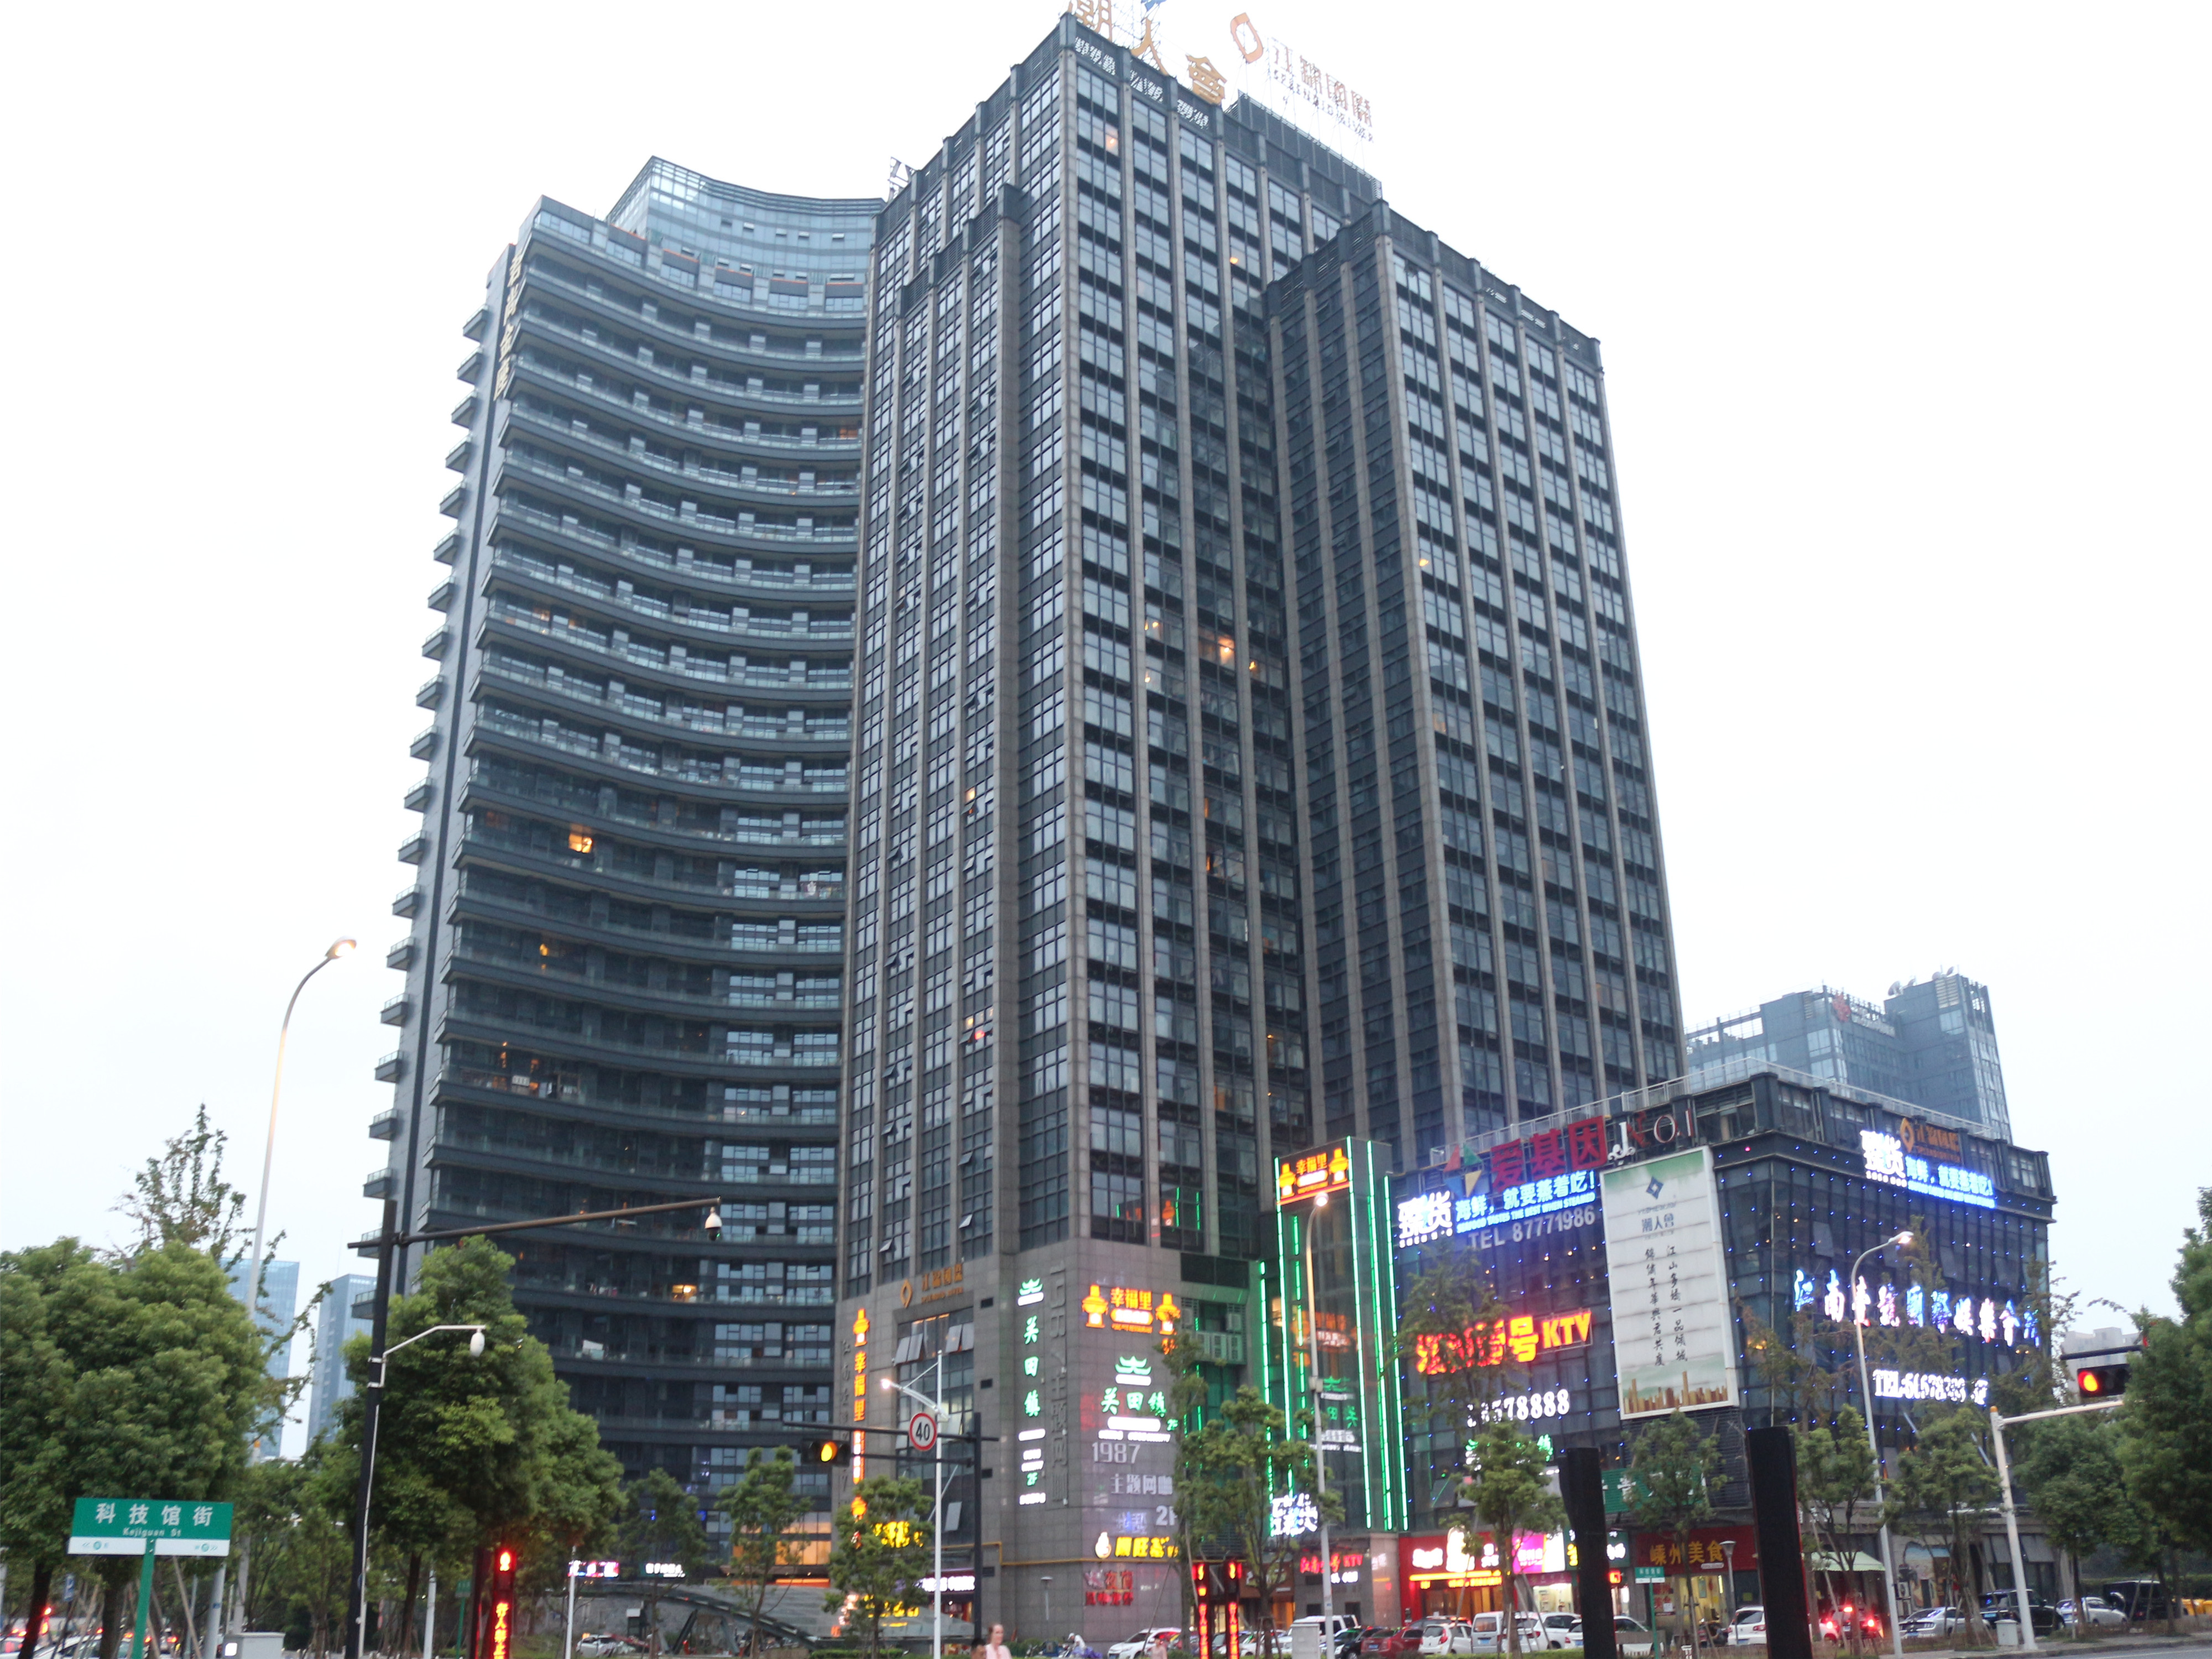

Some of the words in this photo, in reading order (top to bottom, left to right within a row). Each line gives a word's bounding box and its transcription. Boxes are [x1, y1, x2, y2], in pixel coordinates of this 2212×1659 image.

[1296, 1152, 1328, 1175] 幸福里
[1491, 1115, 1608, 1192] 爱基因
[1468, 1227, 1506, 1250] TEL
[1512, 1205, 1595, 1243] 87771986
[1110, 1287, 1152, 1311] 幸福里
[1542, 1312, 1592, 1349] KTV
[854, 1351, 867, 1421] 幸福里
[916, 1422, 931, 1442] 40
[1092, 1442, 1140, 1464] 1987
[95, 1502, 213, 1527] 科技馆街
[170, 1528, 182, 1537] St
